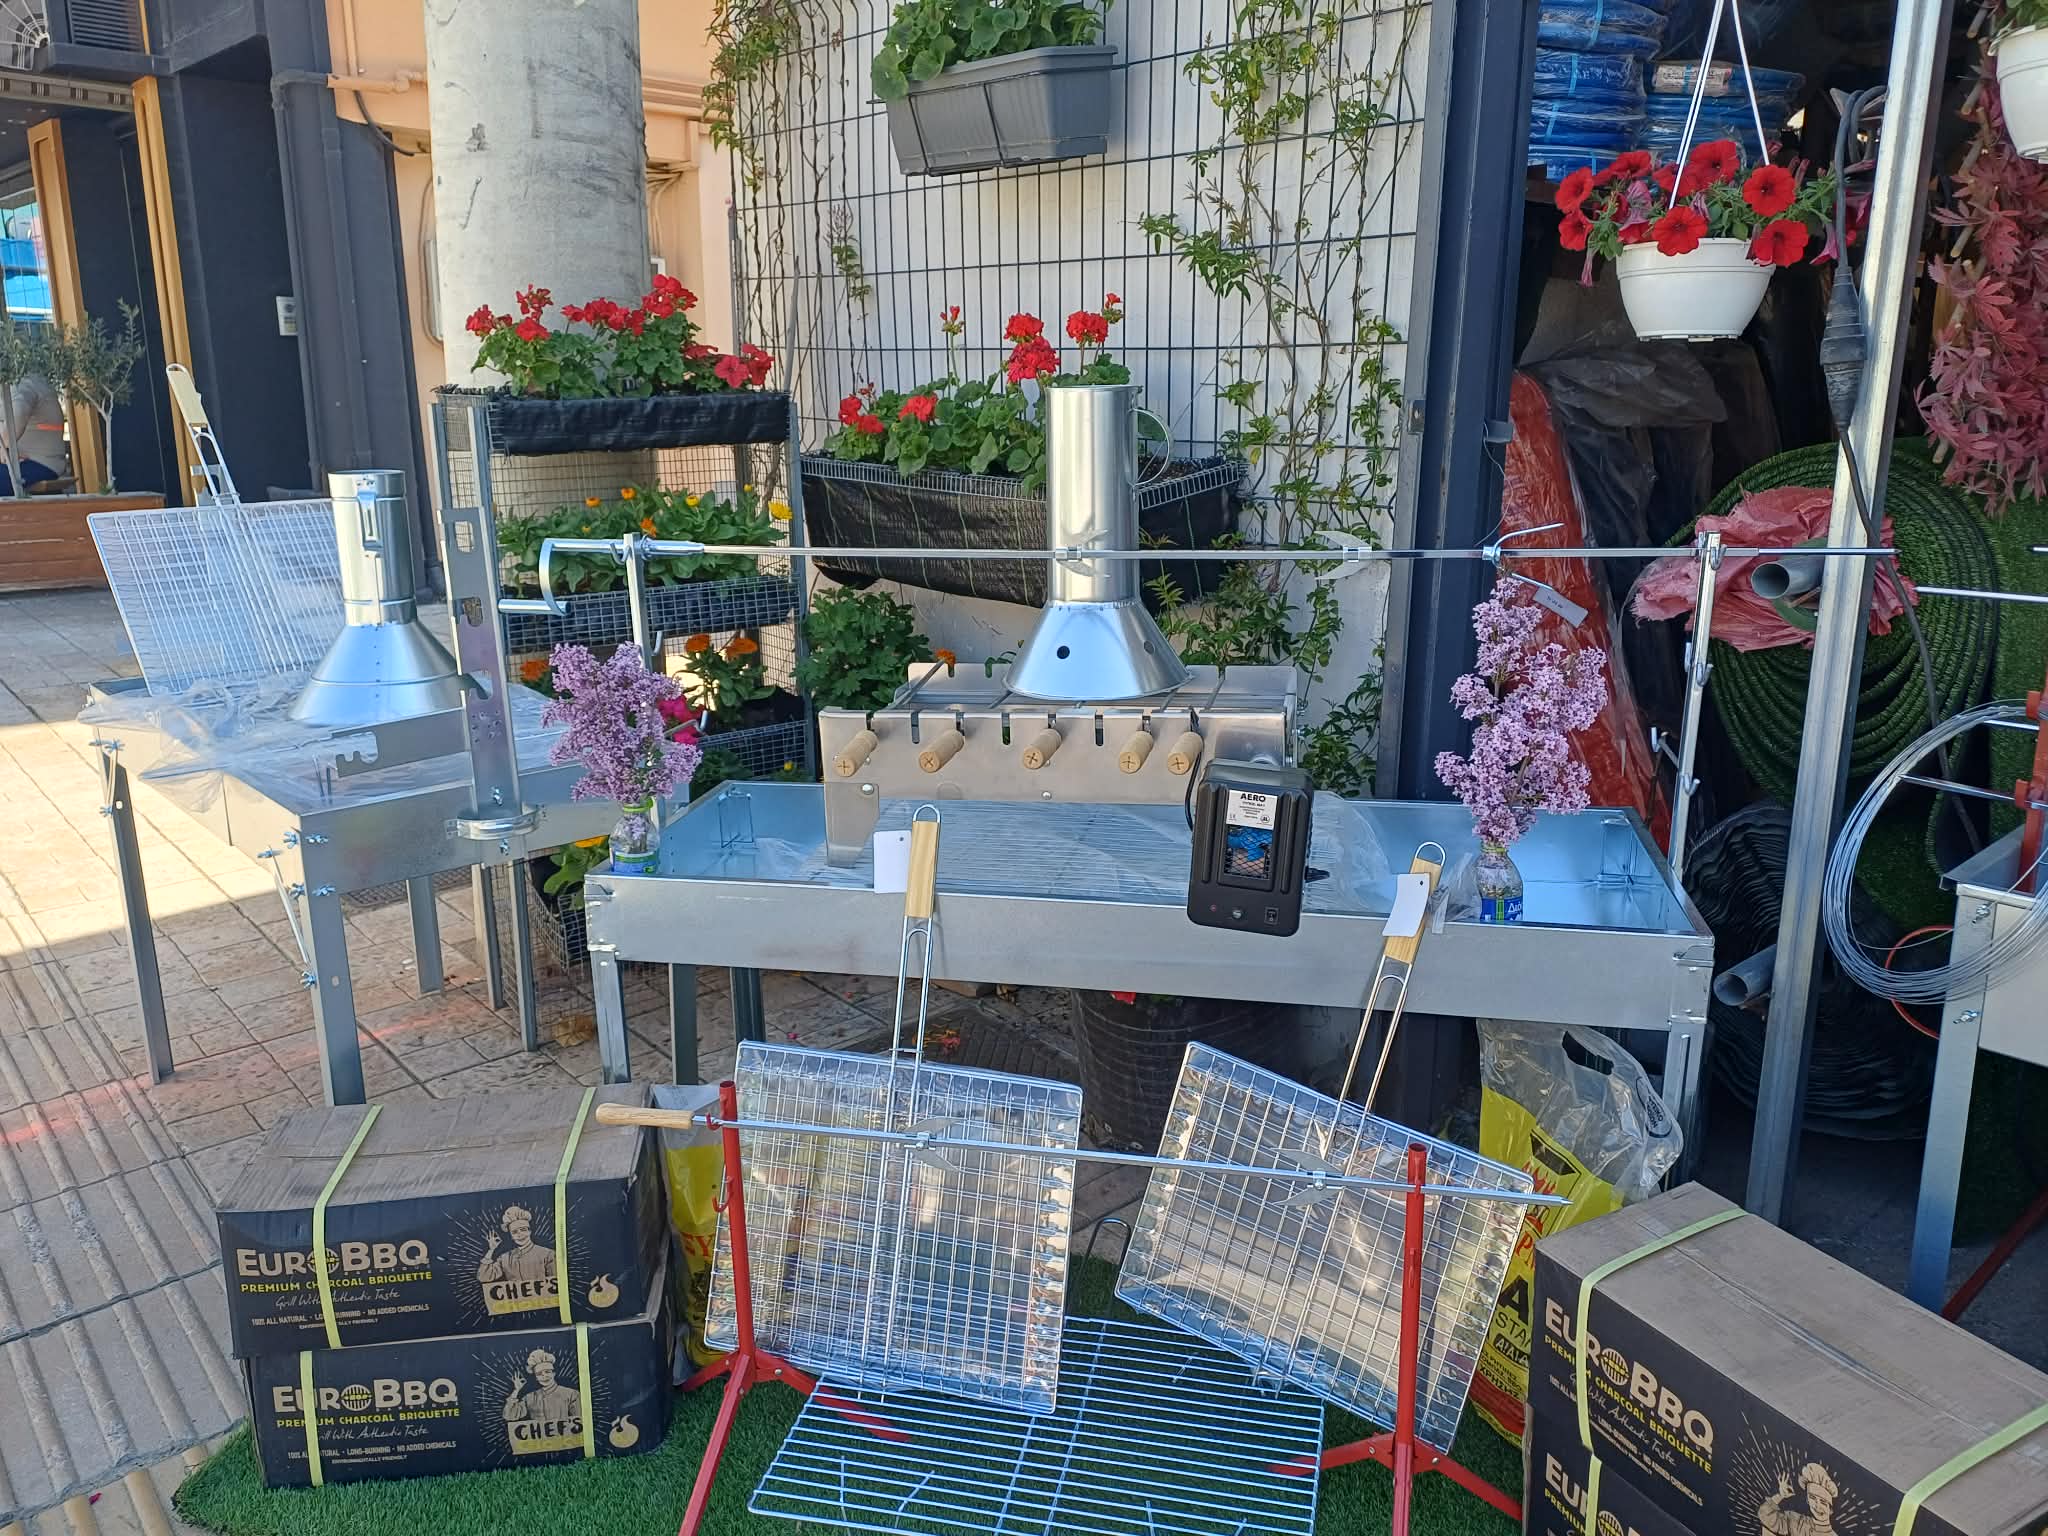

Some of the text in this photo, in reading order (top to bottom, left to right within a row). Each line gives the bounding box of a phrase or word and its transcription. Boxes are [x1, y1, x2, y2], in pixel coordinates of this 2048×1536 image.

[1240, 793, 1266, 802] AERO
[240, 1271, 433, 1293] PREMIUM CHRCOAL BRIQUETTE
[375, 1287, 401, 1301] Taste
[266, 1317, 279, 1325] ALL
[1544, 1334, 1592, 1379] PREMIM
[1595, 1377, 1646, 1423] CHARCOAL
[1649, 1419, 1712, 1474] BRIQUETTE
[339, 1413, 395, 1425] CHARCOAL
[399, 1408, 460, 1421] BRIQUETTE
[356, 1425, 402, 1439] Authentic
[405, 1424, 430, 1437] Taste
[514, 1417, 583, 1440] CHEF'S
